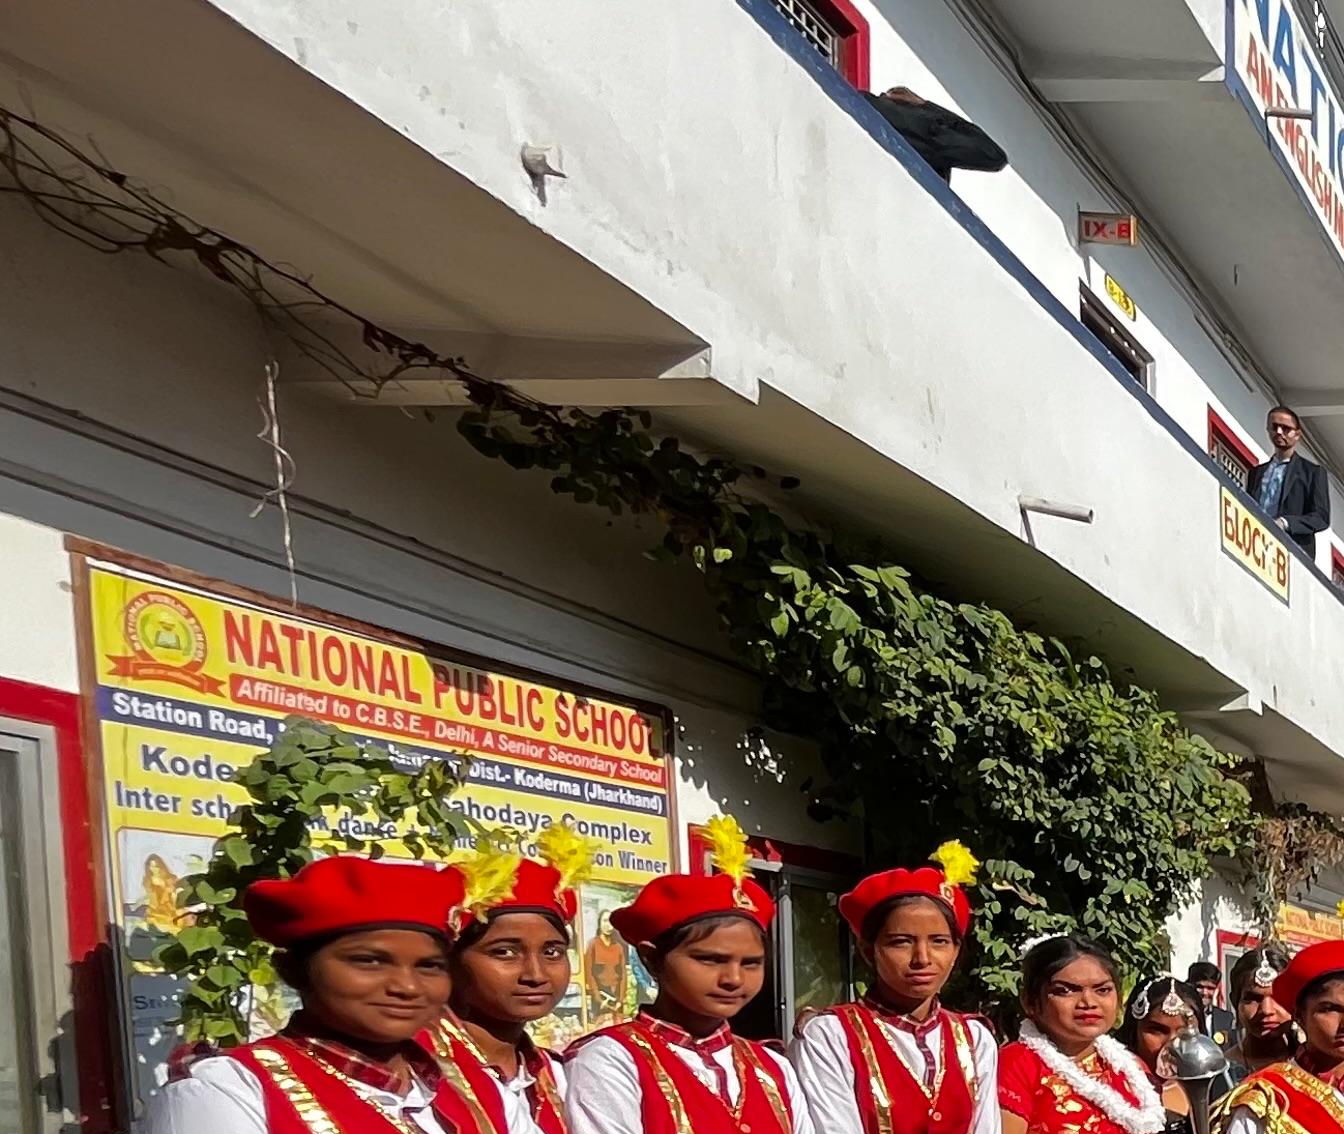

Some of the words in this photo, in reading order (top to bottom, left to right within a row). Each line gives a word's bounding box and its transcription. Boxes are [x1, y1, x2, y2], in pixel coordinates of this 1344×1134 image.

[1247, 32, 1273, 110] AN
[223, 609, 422, 705] NATIONAL
[433, 662, 545, 732] PUBLIC
[554, 693, 660, 760] SCHOOL
[237, 678, 327, 714] Affiliated
[332, 698, 351, 720] to
[355, 703, 430, 738] C.B.S.E.,
[434, 720, 478, 747] Delhi,
[483, 731, 494, 749] A
[498, 736, 545, 760] Senior
[548, 743, 618, 778] Secondary
[620, 760, 663, 784] School
[112, 691, 203, 729] Station
[209, 715, 274, 745] Road,
[514, 771, 581, 797] Koderma
[584, 783, 663, 814] (Jharkhand)
[142, 744, 234, 783] Kode
[451, 796, 553, 834] ahodaya
[562, 813, 652, 845] Complex
[115, 780, 182, 813] Inter
[192, 794, 232, 819] sch
[618, 850, 668, 874] Winner
